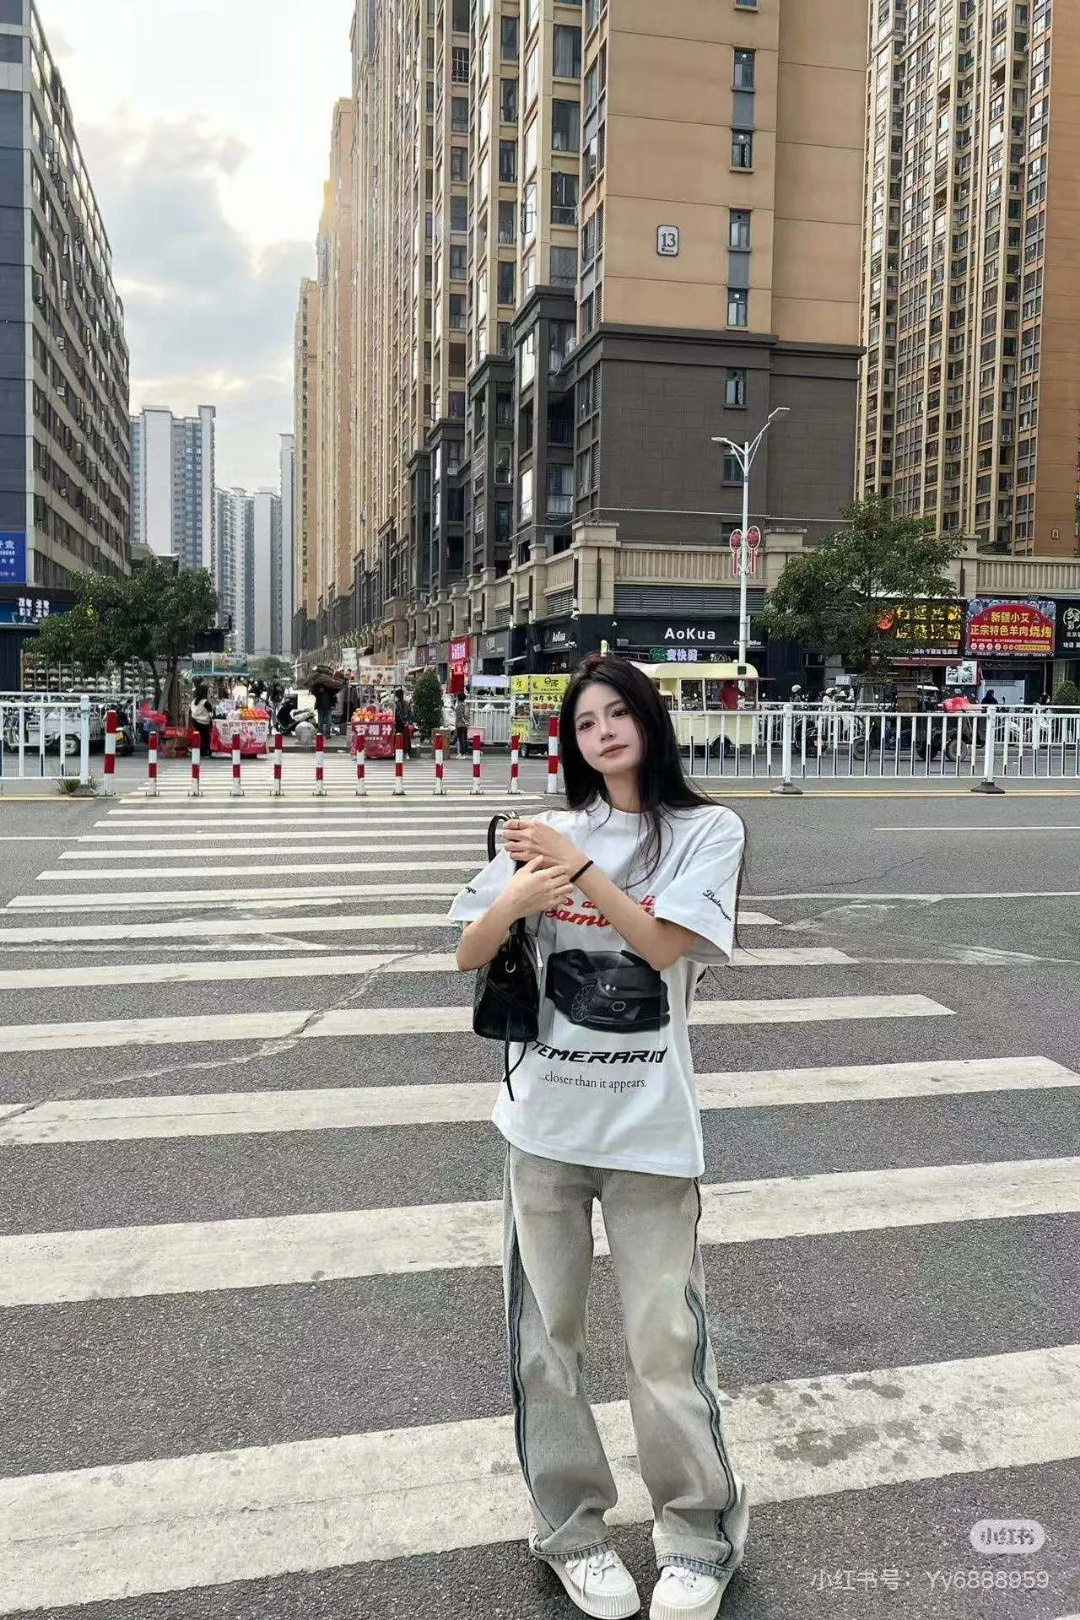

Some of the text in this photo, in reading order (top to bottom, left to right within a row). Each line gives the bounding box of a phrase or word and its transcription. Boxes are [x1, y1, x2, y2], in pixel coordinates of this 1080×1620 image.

[661, 233, 676, 247] 13
[664, 627, 716, 640] AoKua
[970, 623, 1052, 637] 正宗特色羊肉烧烤
[531, 1040, 668, 1064] TEMERARIO
[575, 1075, 597, 1088] than
[599, 1078, 607, 1089] it
[608, 1078, 647, 1094] appears.
